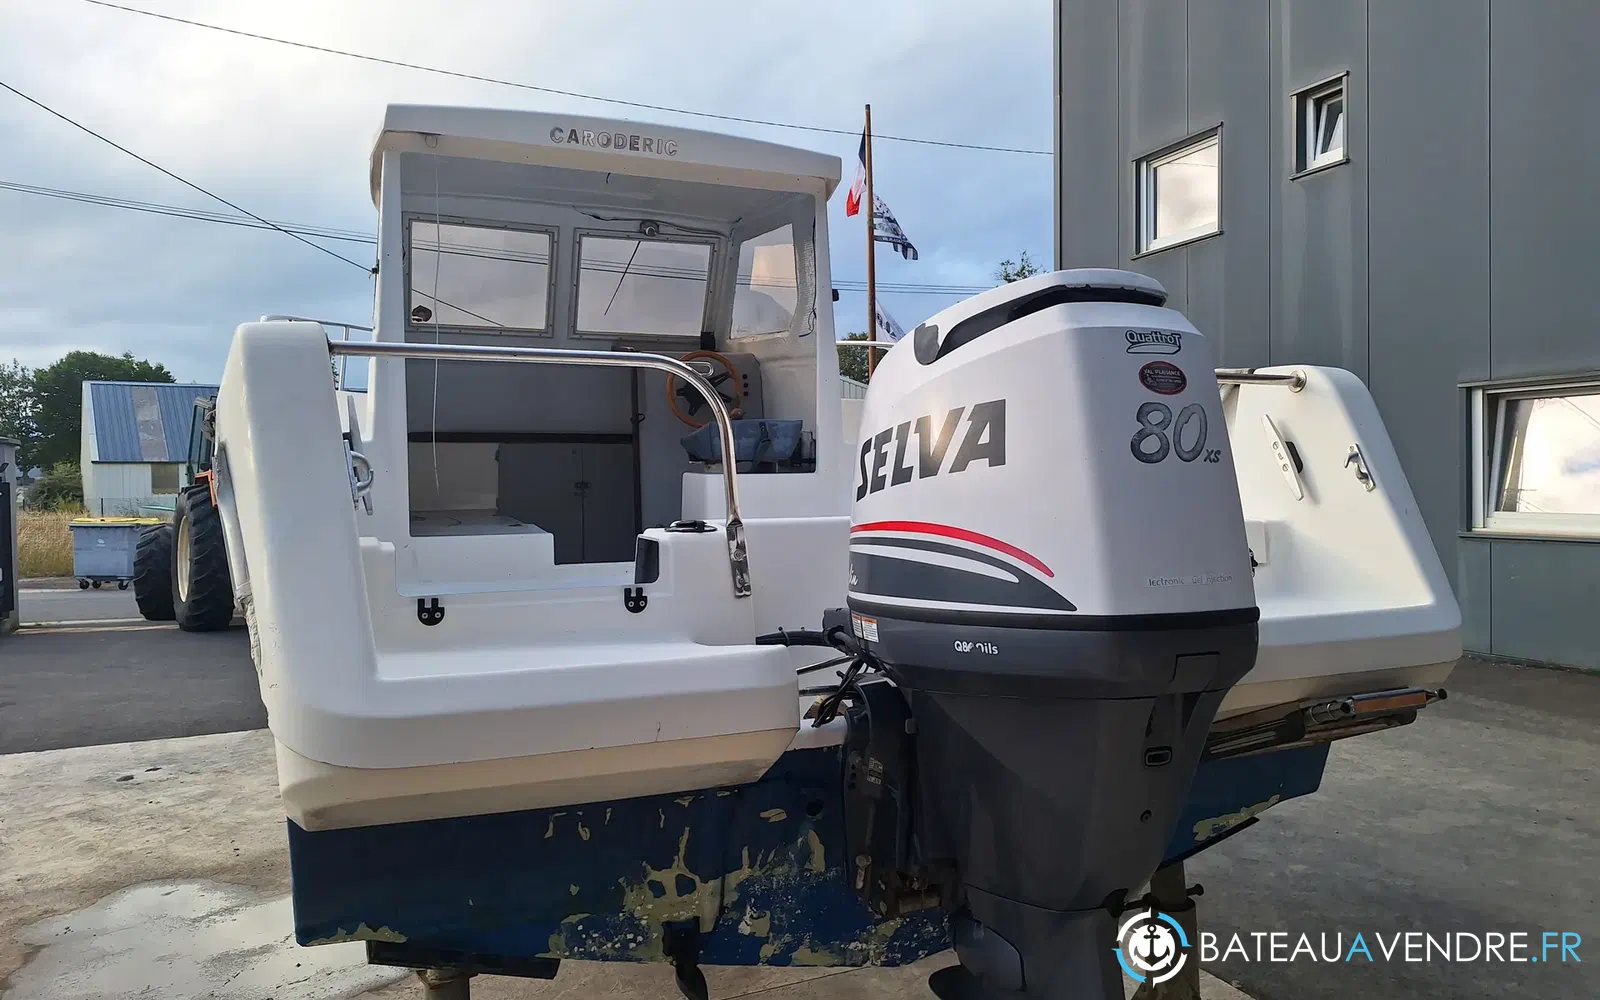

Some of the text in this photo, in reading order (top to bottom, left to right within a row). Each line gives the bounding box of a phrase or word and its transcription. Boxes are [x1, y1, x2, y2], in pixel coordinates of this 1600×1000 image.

[549, 126, 678, 156] CARODERIC
[856, 398, 1006, 503] SELVA
[1130, 401, 1208, 464] 80
